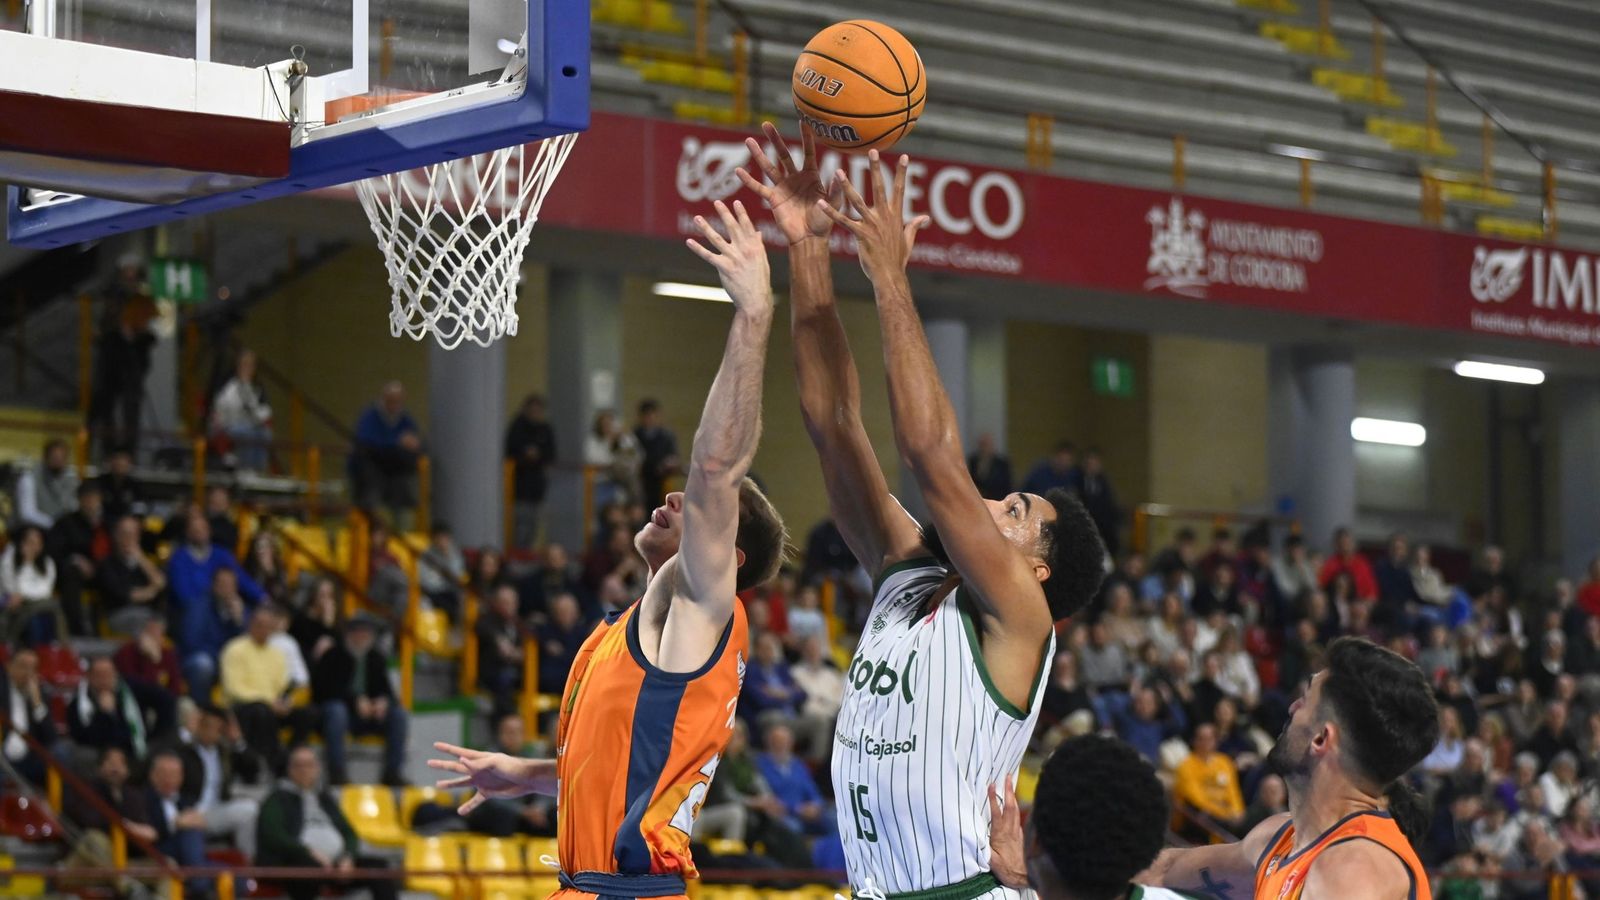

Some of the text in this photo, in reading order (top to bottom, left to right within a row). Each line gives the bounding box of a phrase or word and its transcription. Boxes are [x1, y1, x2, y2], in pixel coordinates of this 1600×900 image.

[800, 67, 845, 98] EVO
[1531, 249, 1600, 315] IM
[865, 734, 917, 761] Cajasol
[848, 784, 879, 843] 15
